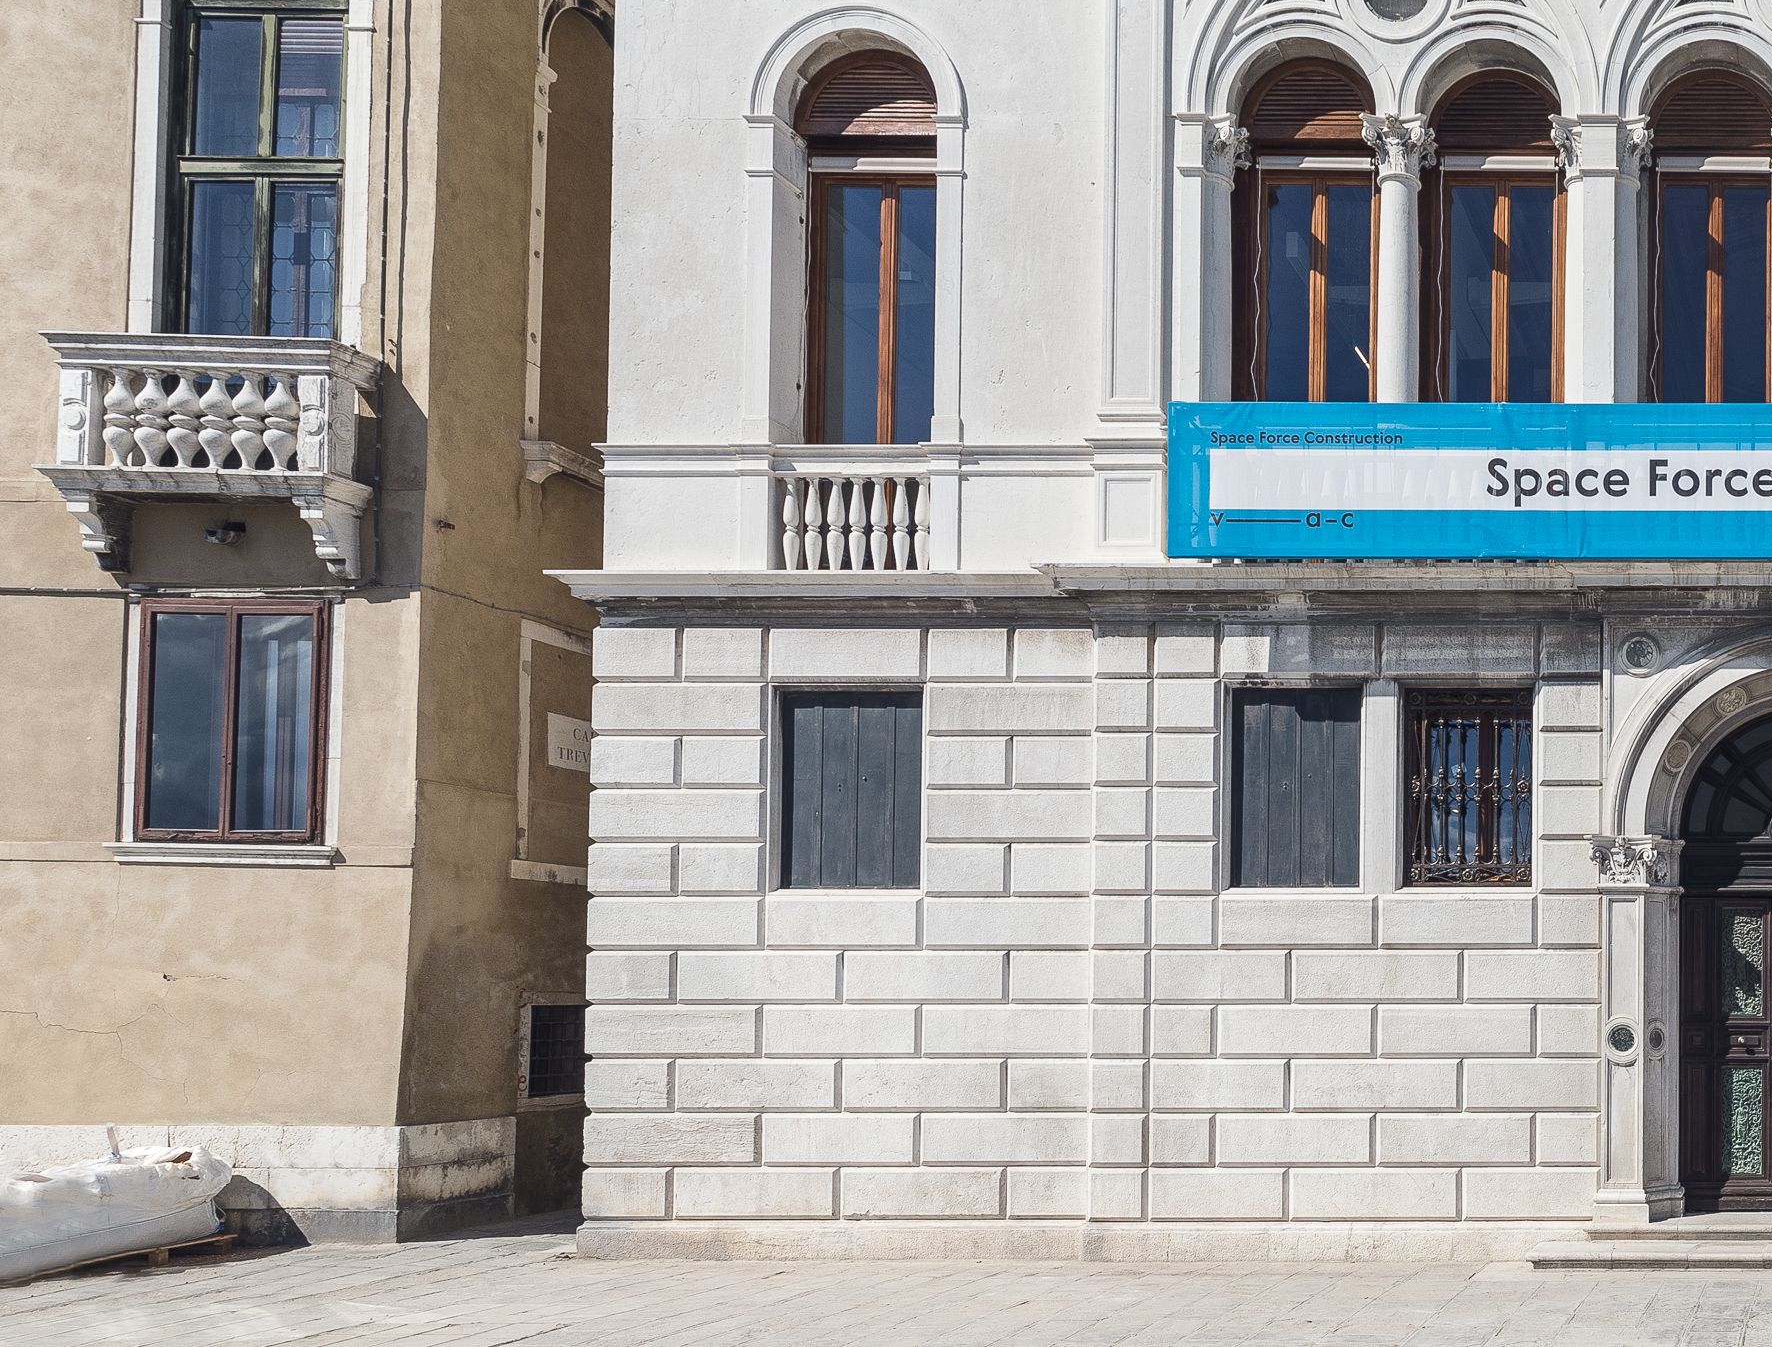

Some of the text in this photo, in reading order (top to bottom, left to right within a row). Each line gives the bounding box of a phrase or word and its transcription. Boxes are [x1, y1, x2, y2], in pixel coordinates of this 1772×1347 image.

[1210, 431, 1403, 447] Space Force Construction
[1486, 457, 1630, 508] Space
